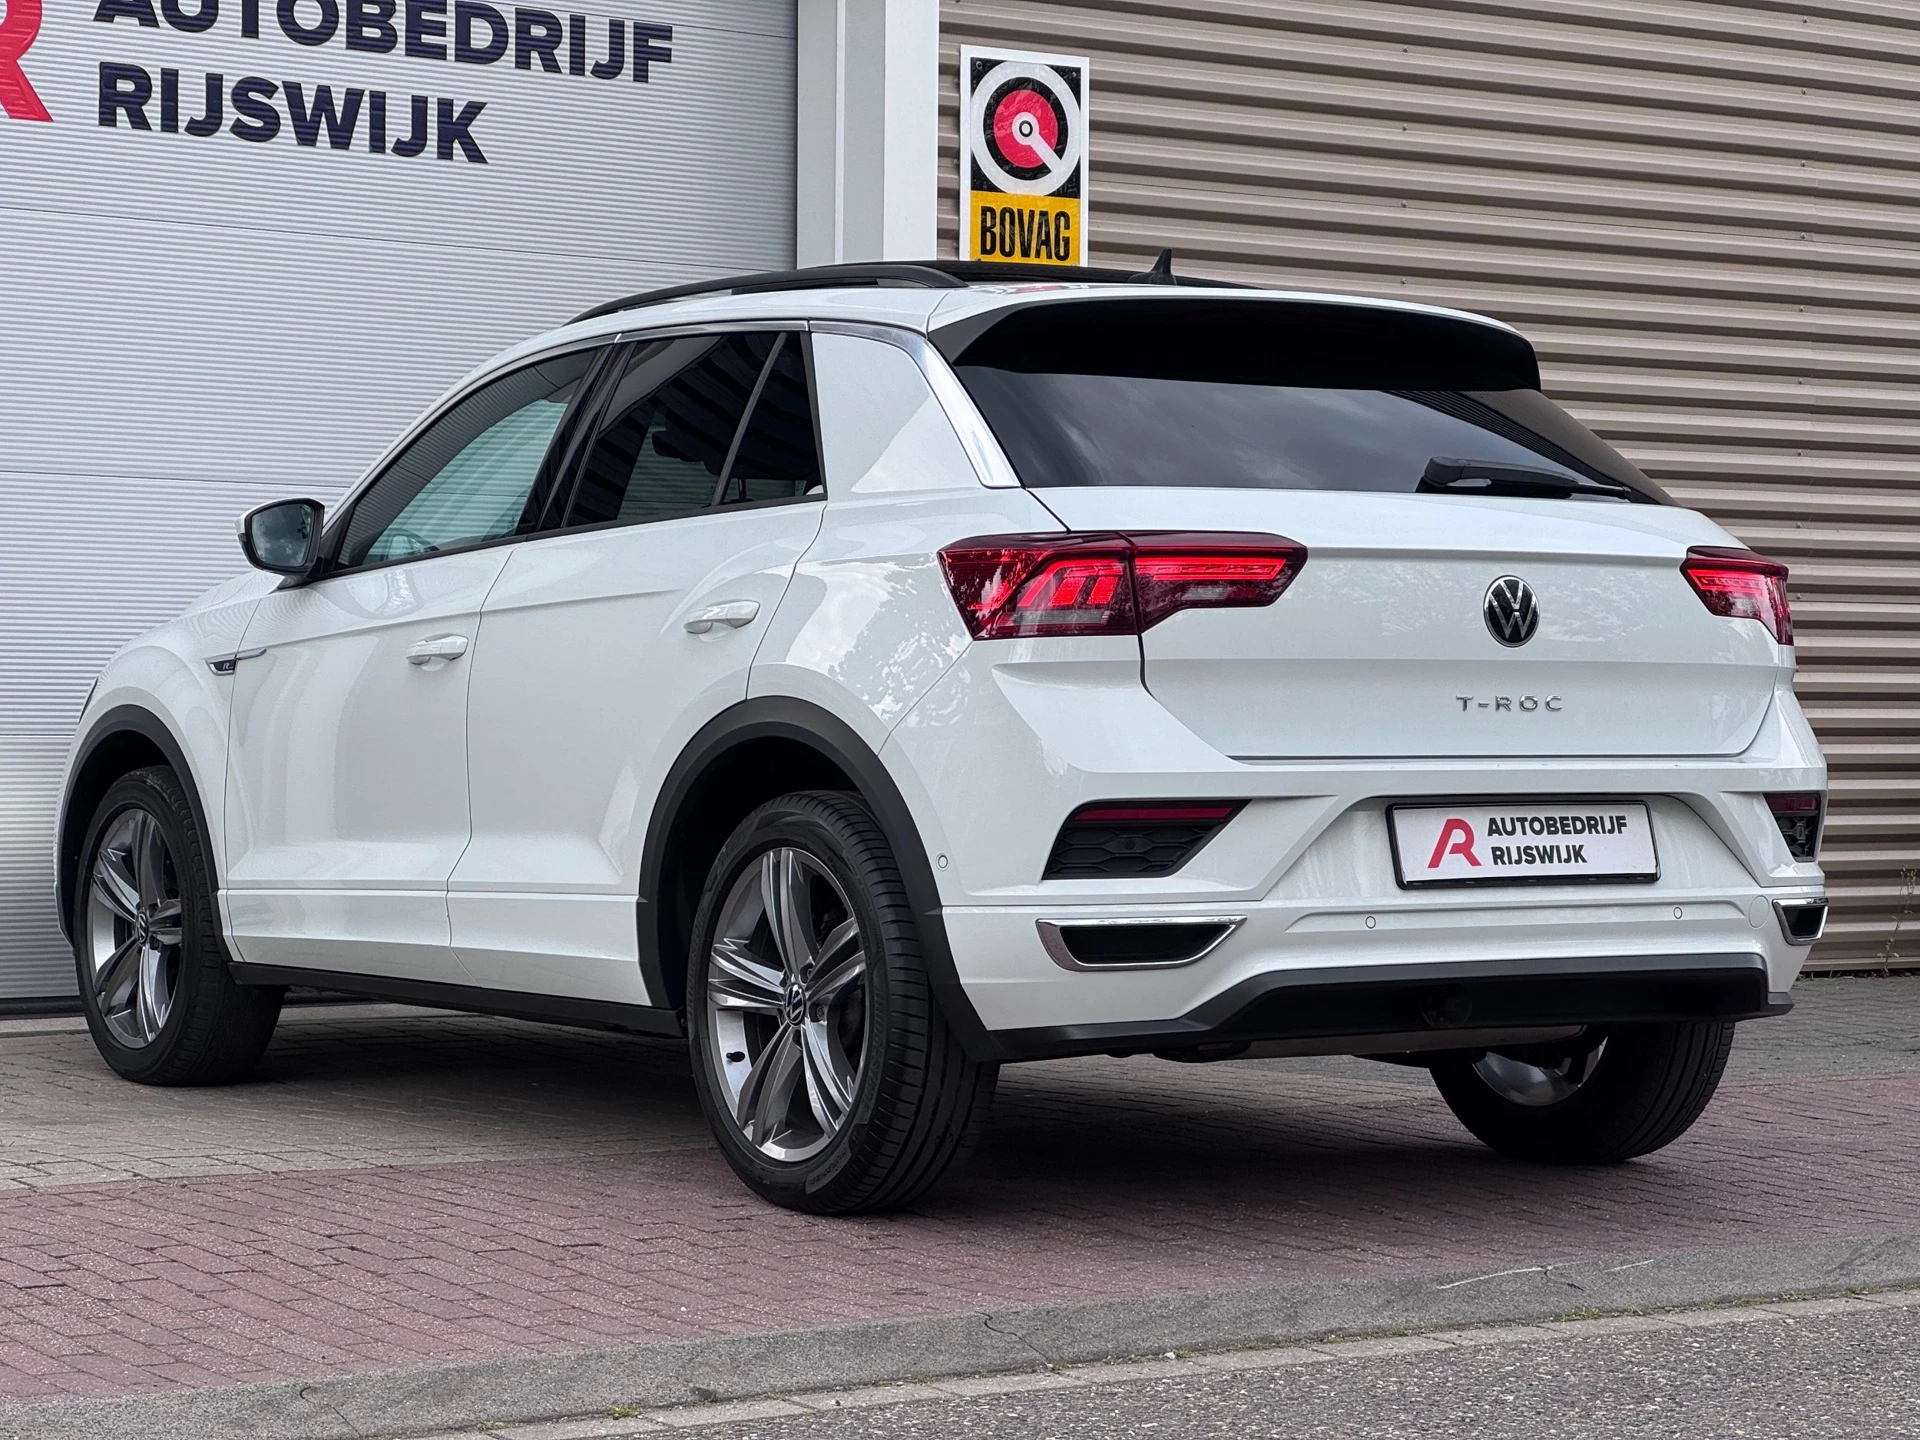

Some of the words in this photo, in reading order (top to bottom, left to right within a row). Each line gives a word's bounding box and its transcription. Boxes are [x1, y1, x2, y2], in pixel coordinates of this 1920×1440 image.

[98, 61, 488, 164] RIJSWIJK
[980, 205, 1071, 262] BOVAG
[1456, 694, 1563, 712] T-ROC
[1487, 815, 1628, 837] AUTOBEDRIJF
[1491, 844, 1588, 866] RIJSWIJK
